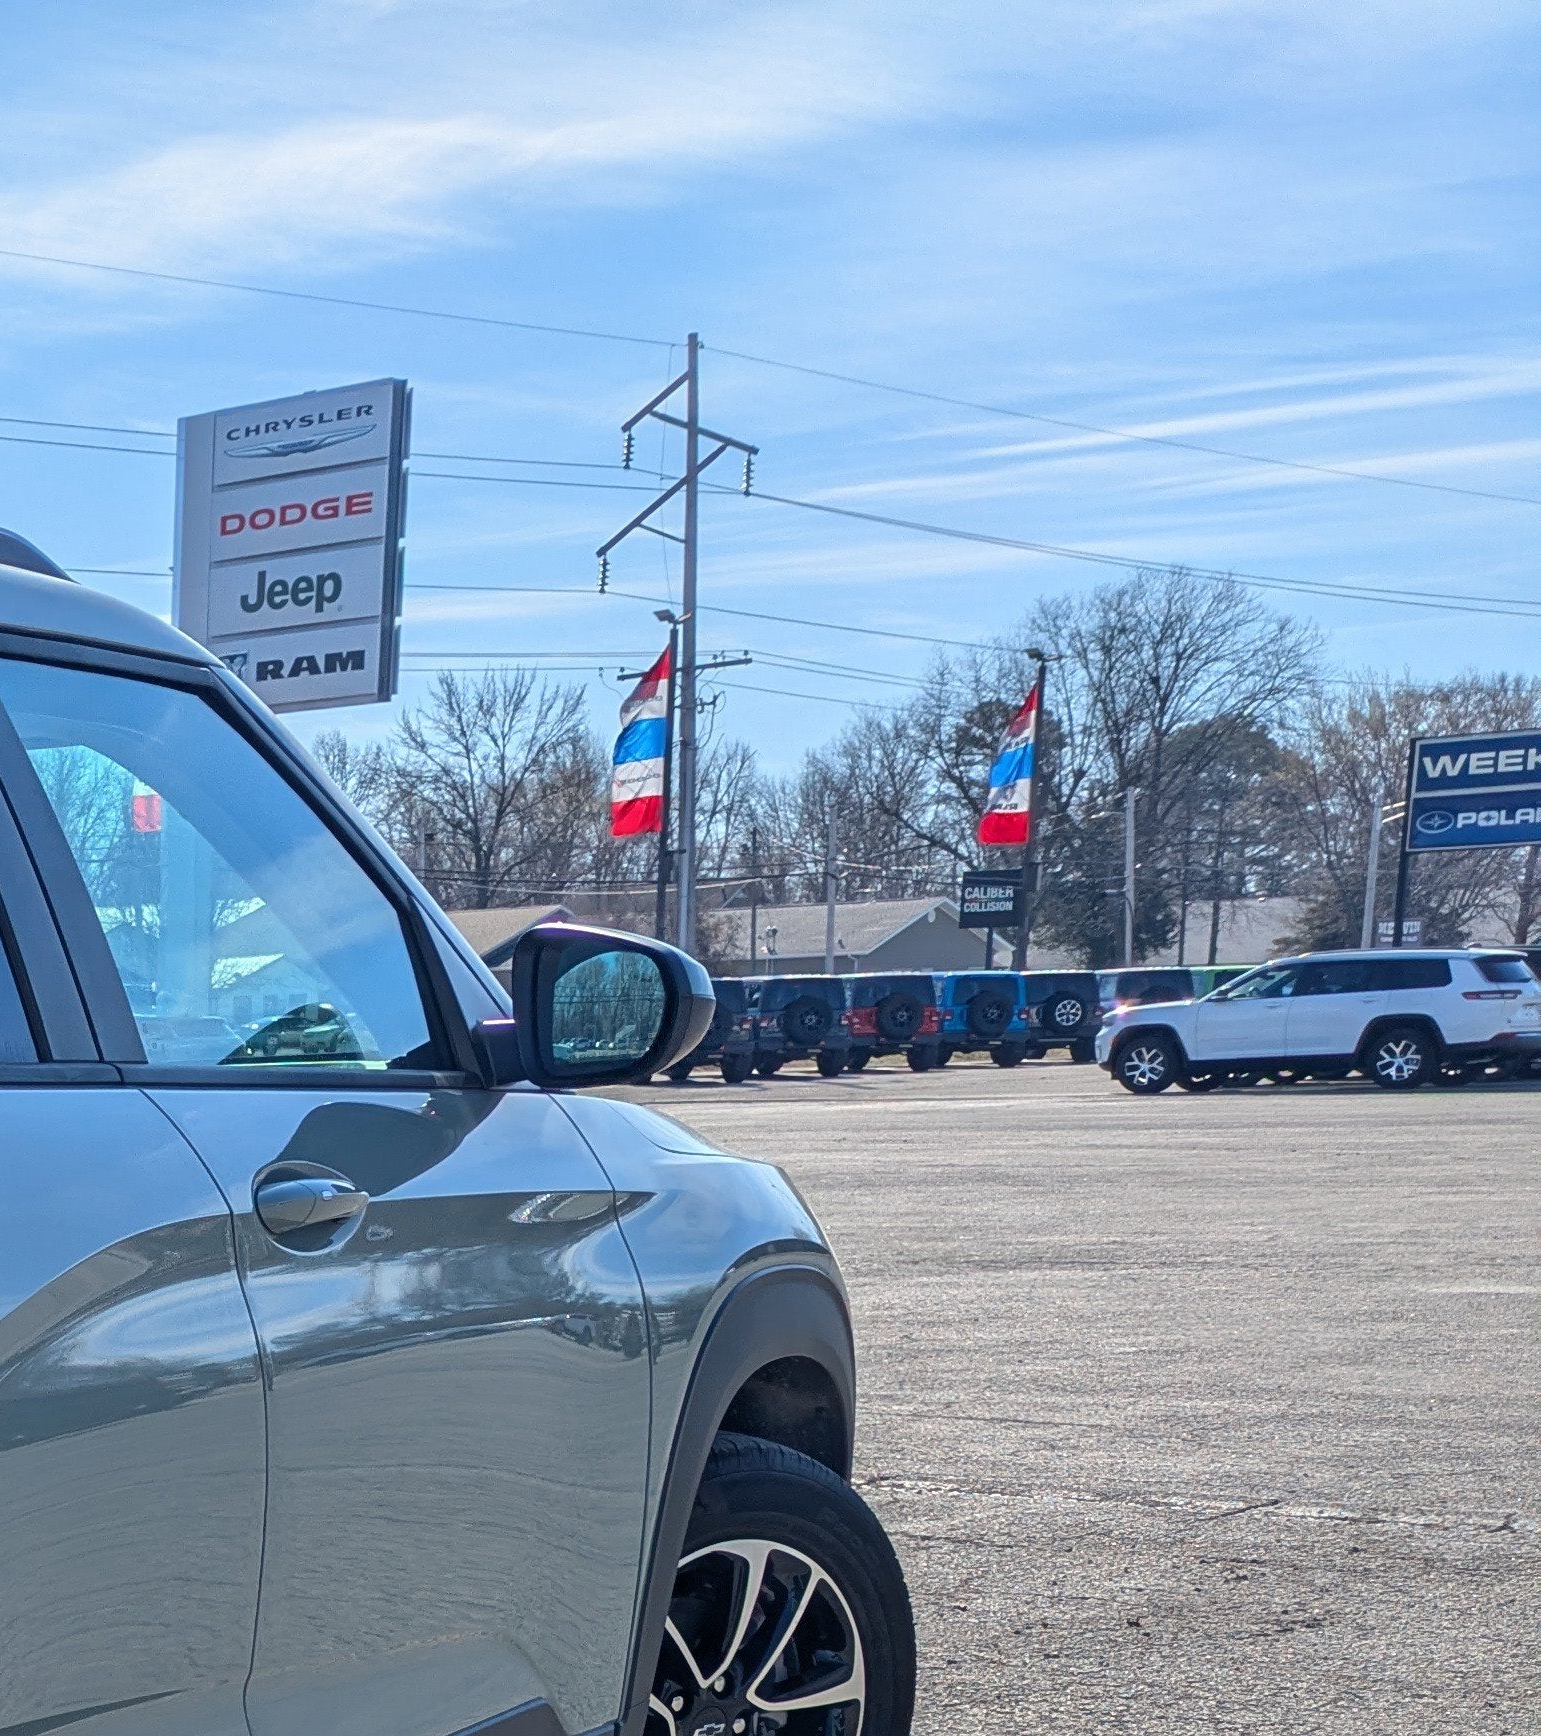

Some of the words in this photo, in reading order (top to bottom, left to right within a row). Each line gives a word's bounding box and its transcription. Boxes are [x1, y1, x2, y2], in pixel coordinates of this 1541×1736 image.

[225, 403, 375, 442] CHRYSLER
[220, 491, 374, 537] DODGE
[239, 570, 343, 614] Jeep
[255, 649, 366, 683] RAM
[1456, 807, 1541, 829] POLA
[963, 900, 1014, 913] COLLISION
[964, 886, 1014, 900] CALIBER
